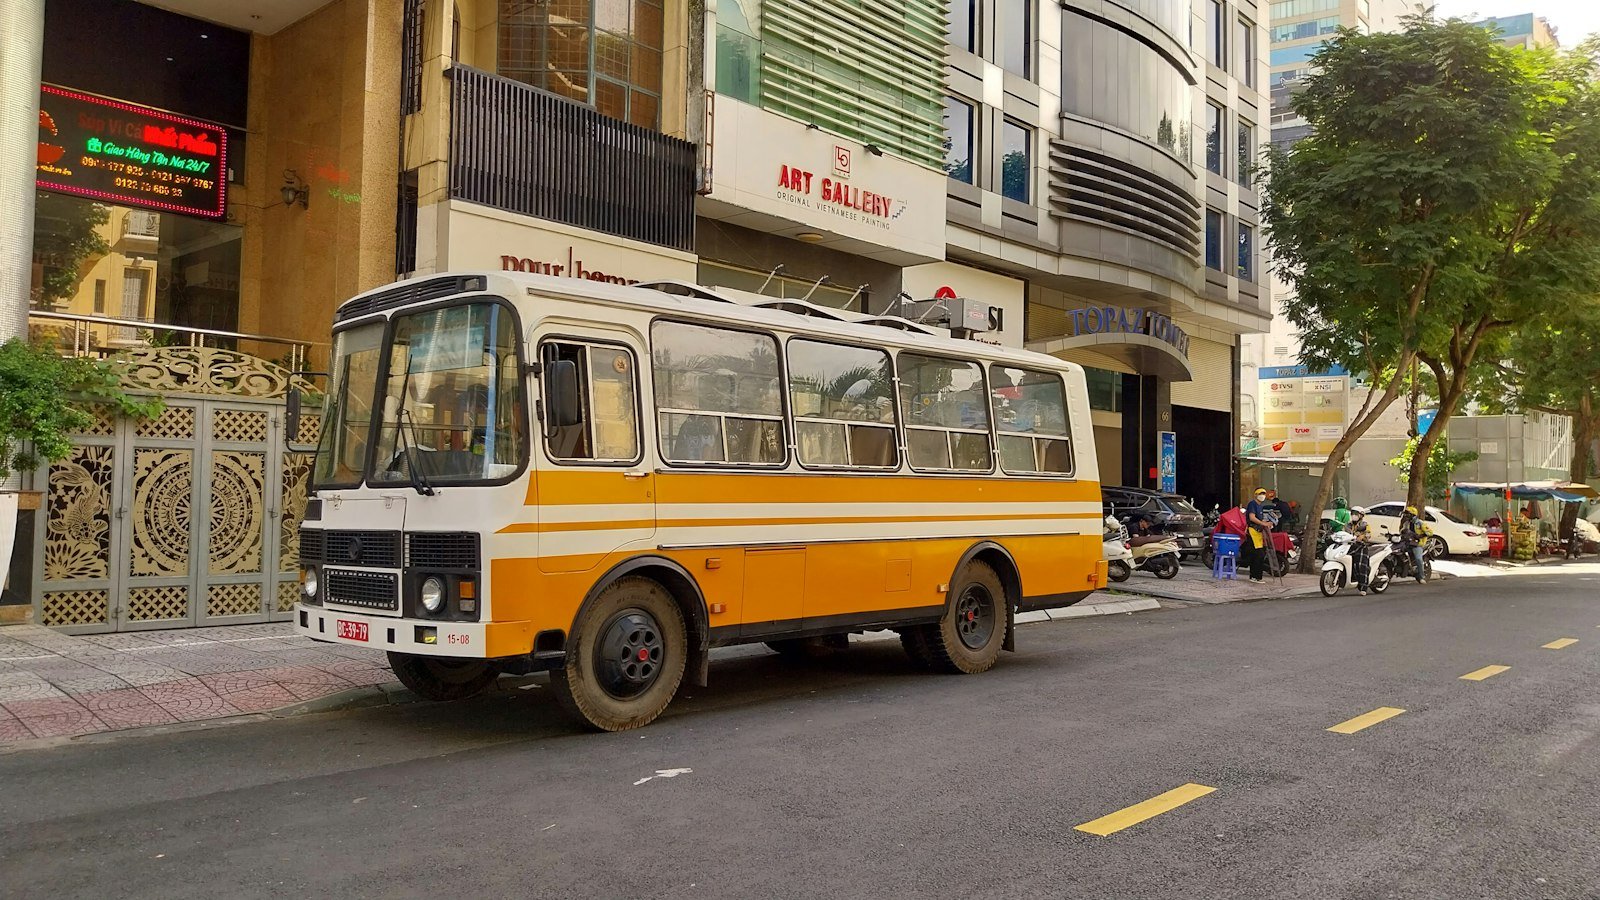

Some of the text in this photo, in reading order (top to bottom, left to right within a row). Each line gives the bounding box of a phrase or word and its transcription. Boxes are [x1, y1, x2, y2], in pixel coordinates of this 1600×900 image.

[103, 141, 124, 156] Giao
[778, 164, 892, 218] ART GALLERY
[777, 191, 890, 230] ORIGINAL VIETNAMESE PAINTING
[1068, 306, 1144, 336] TOPAZ
[447, 634, 470, 645] 15-08
